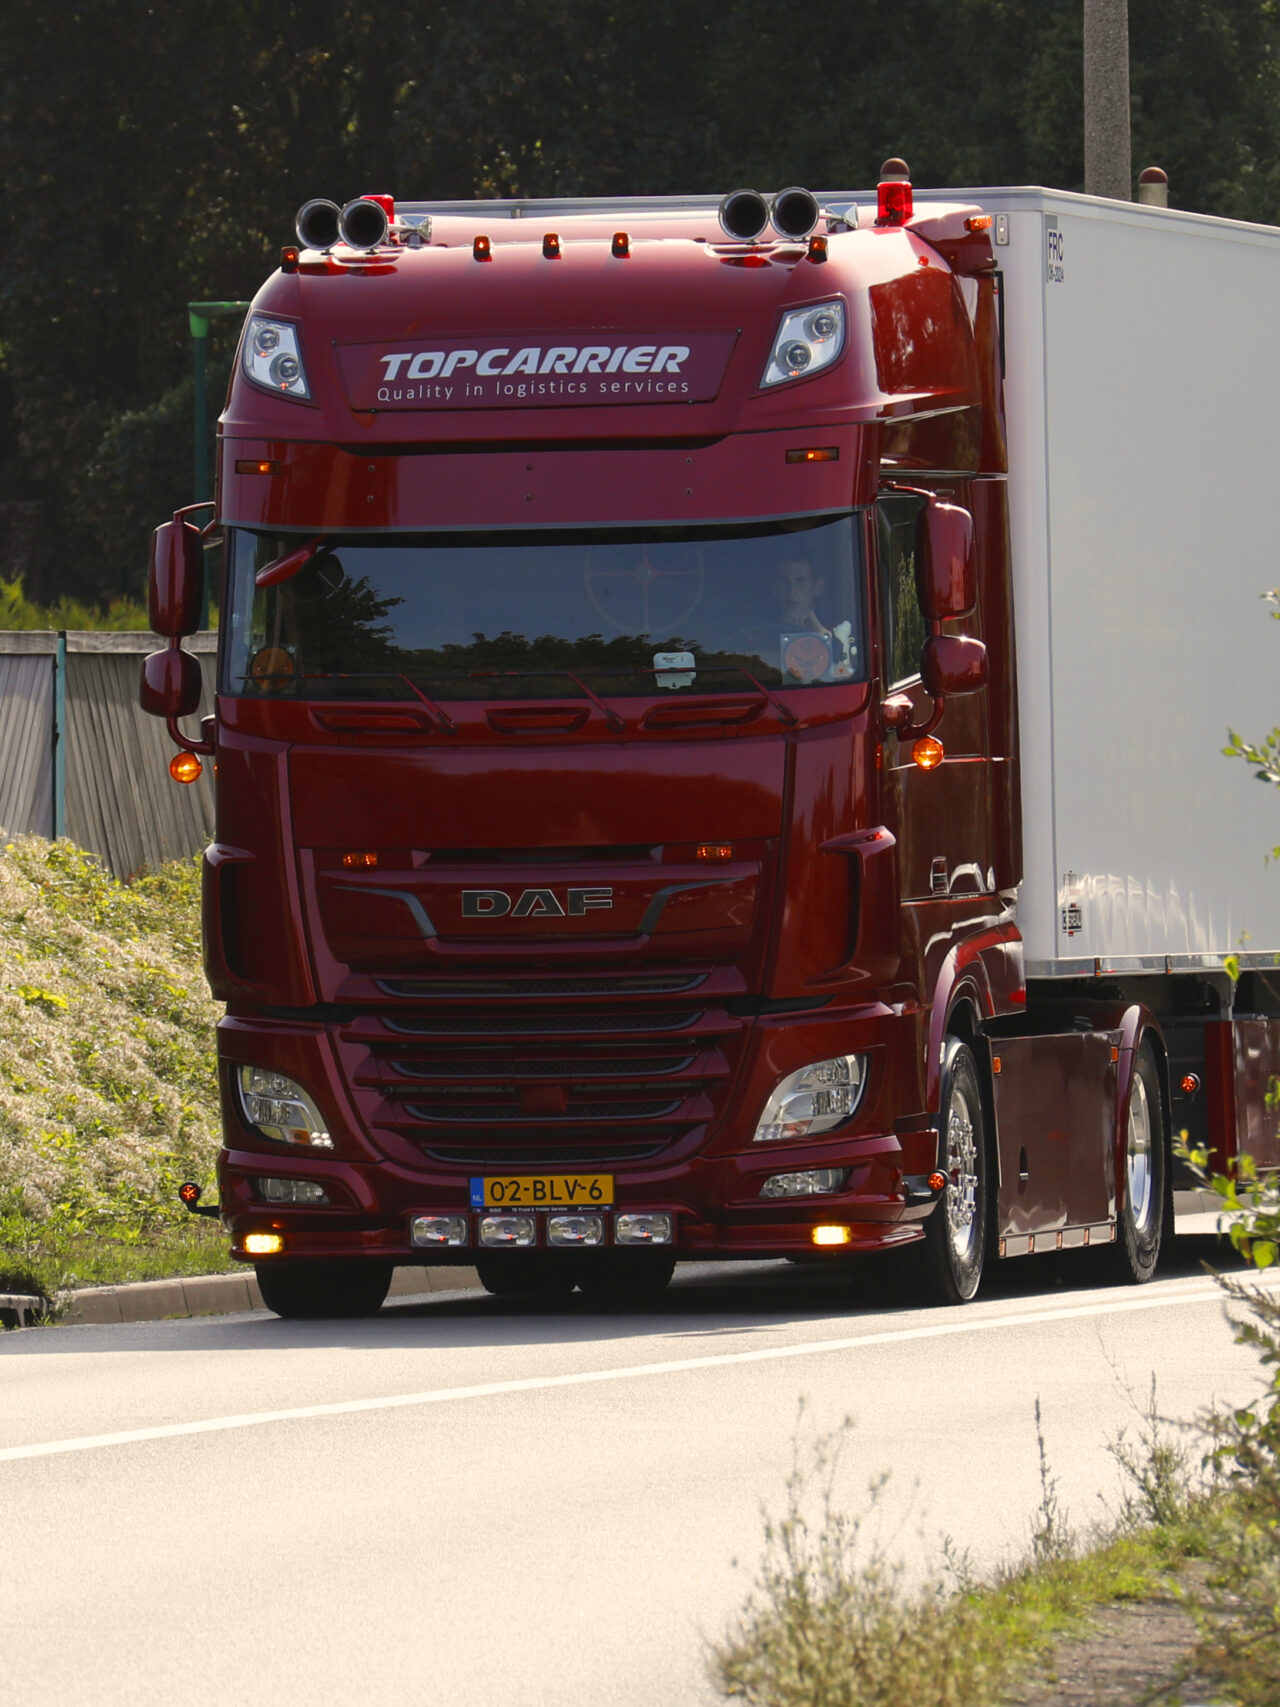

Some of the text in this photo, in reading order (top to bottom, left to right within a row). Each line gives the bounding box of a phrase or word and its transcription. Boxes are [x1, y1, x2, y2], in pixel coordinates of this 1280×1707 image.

[1048, 231, 1064, 261] FRC
[379, 345, 690, 381] TOPCARRIER
[377, 379, 689, 402] Quality in logistics services
[461, 887, 613, 917] DAF
[490, 1179, 603, 1202] 02-BLV-6
